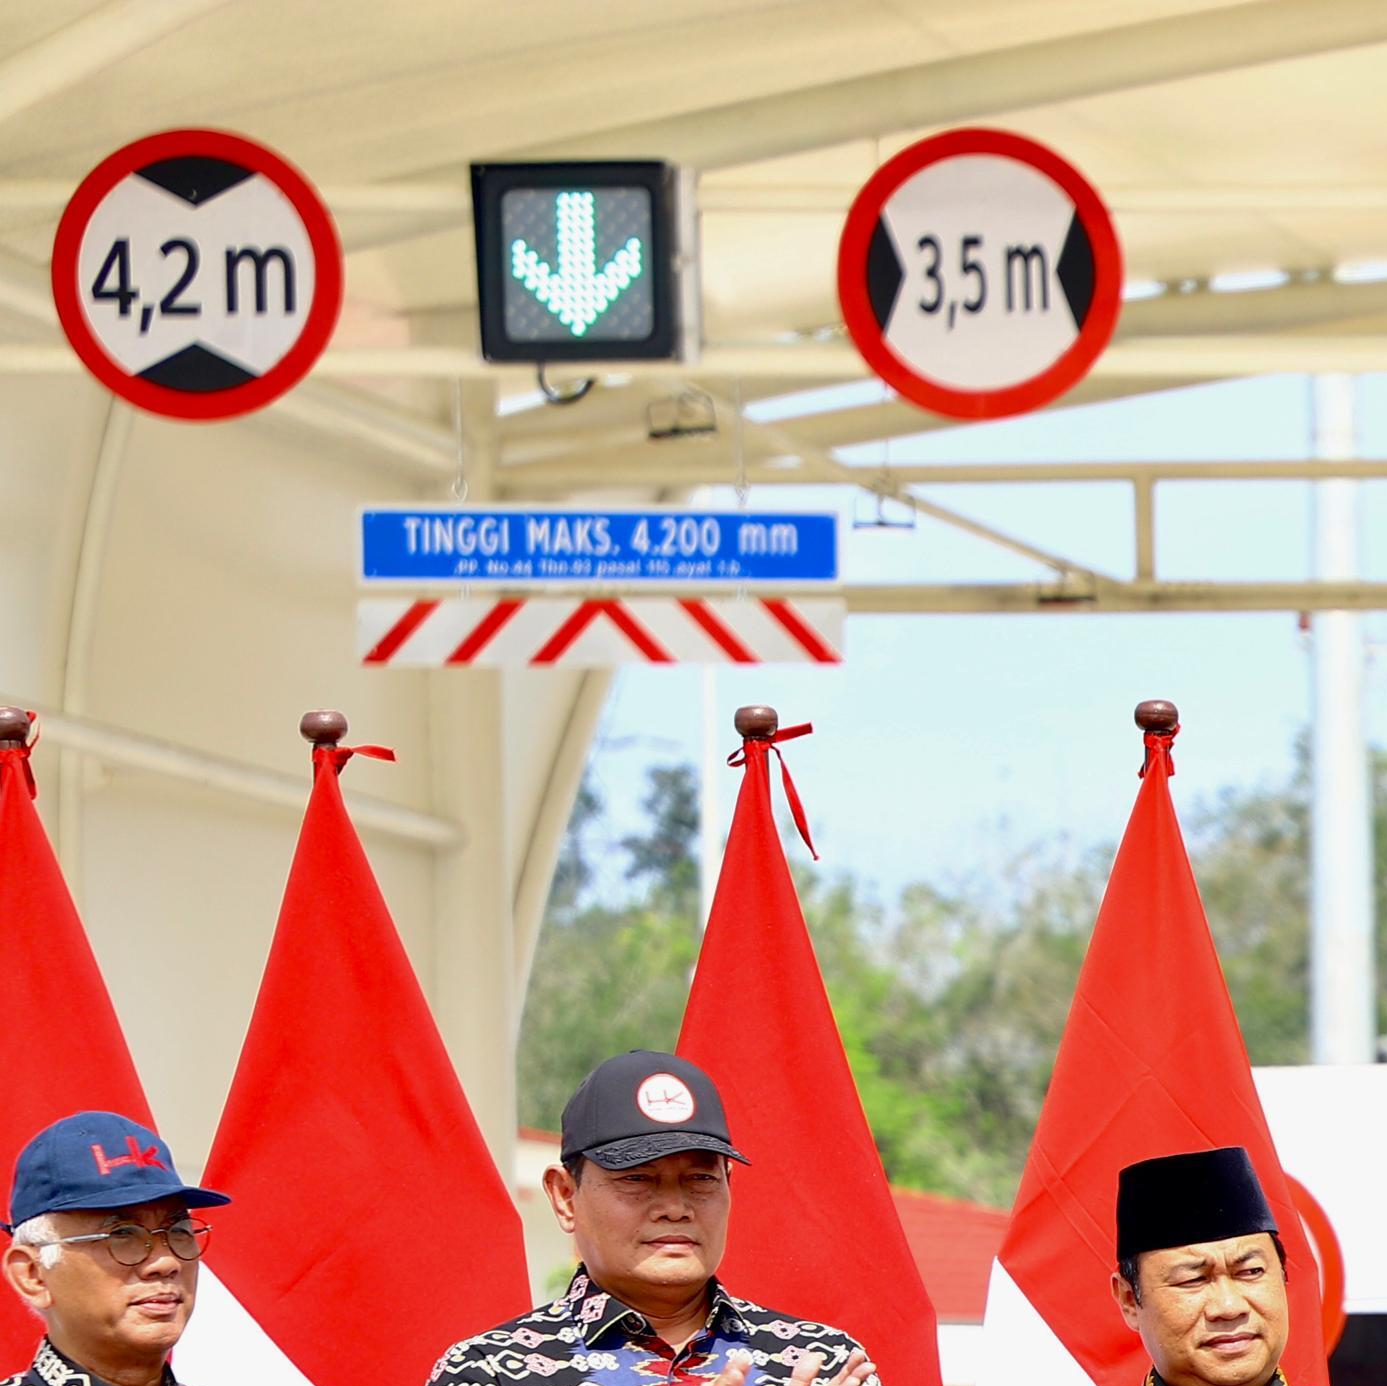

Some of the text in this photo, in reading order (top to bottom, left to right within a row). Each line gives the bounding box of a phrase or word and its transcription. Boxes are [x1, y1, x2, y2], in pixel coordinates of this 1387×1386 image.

[91, 237, 296, 335] 4,2 m
[916, 235, 1049, 329] 3,5 m
[404, 518, 509, 554] TINGGI
[631, 518, 721, 555] 4.200
[739, 522, 799, 553] mm
